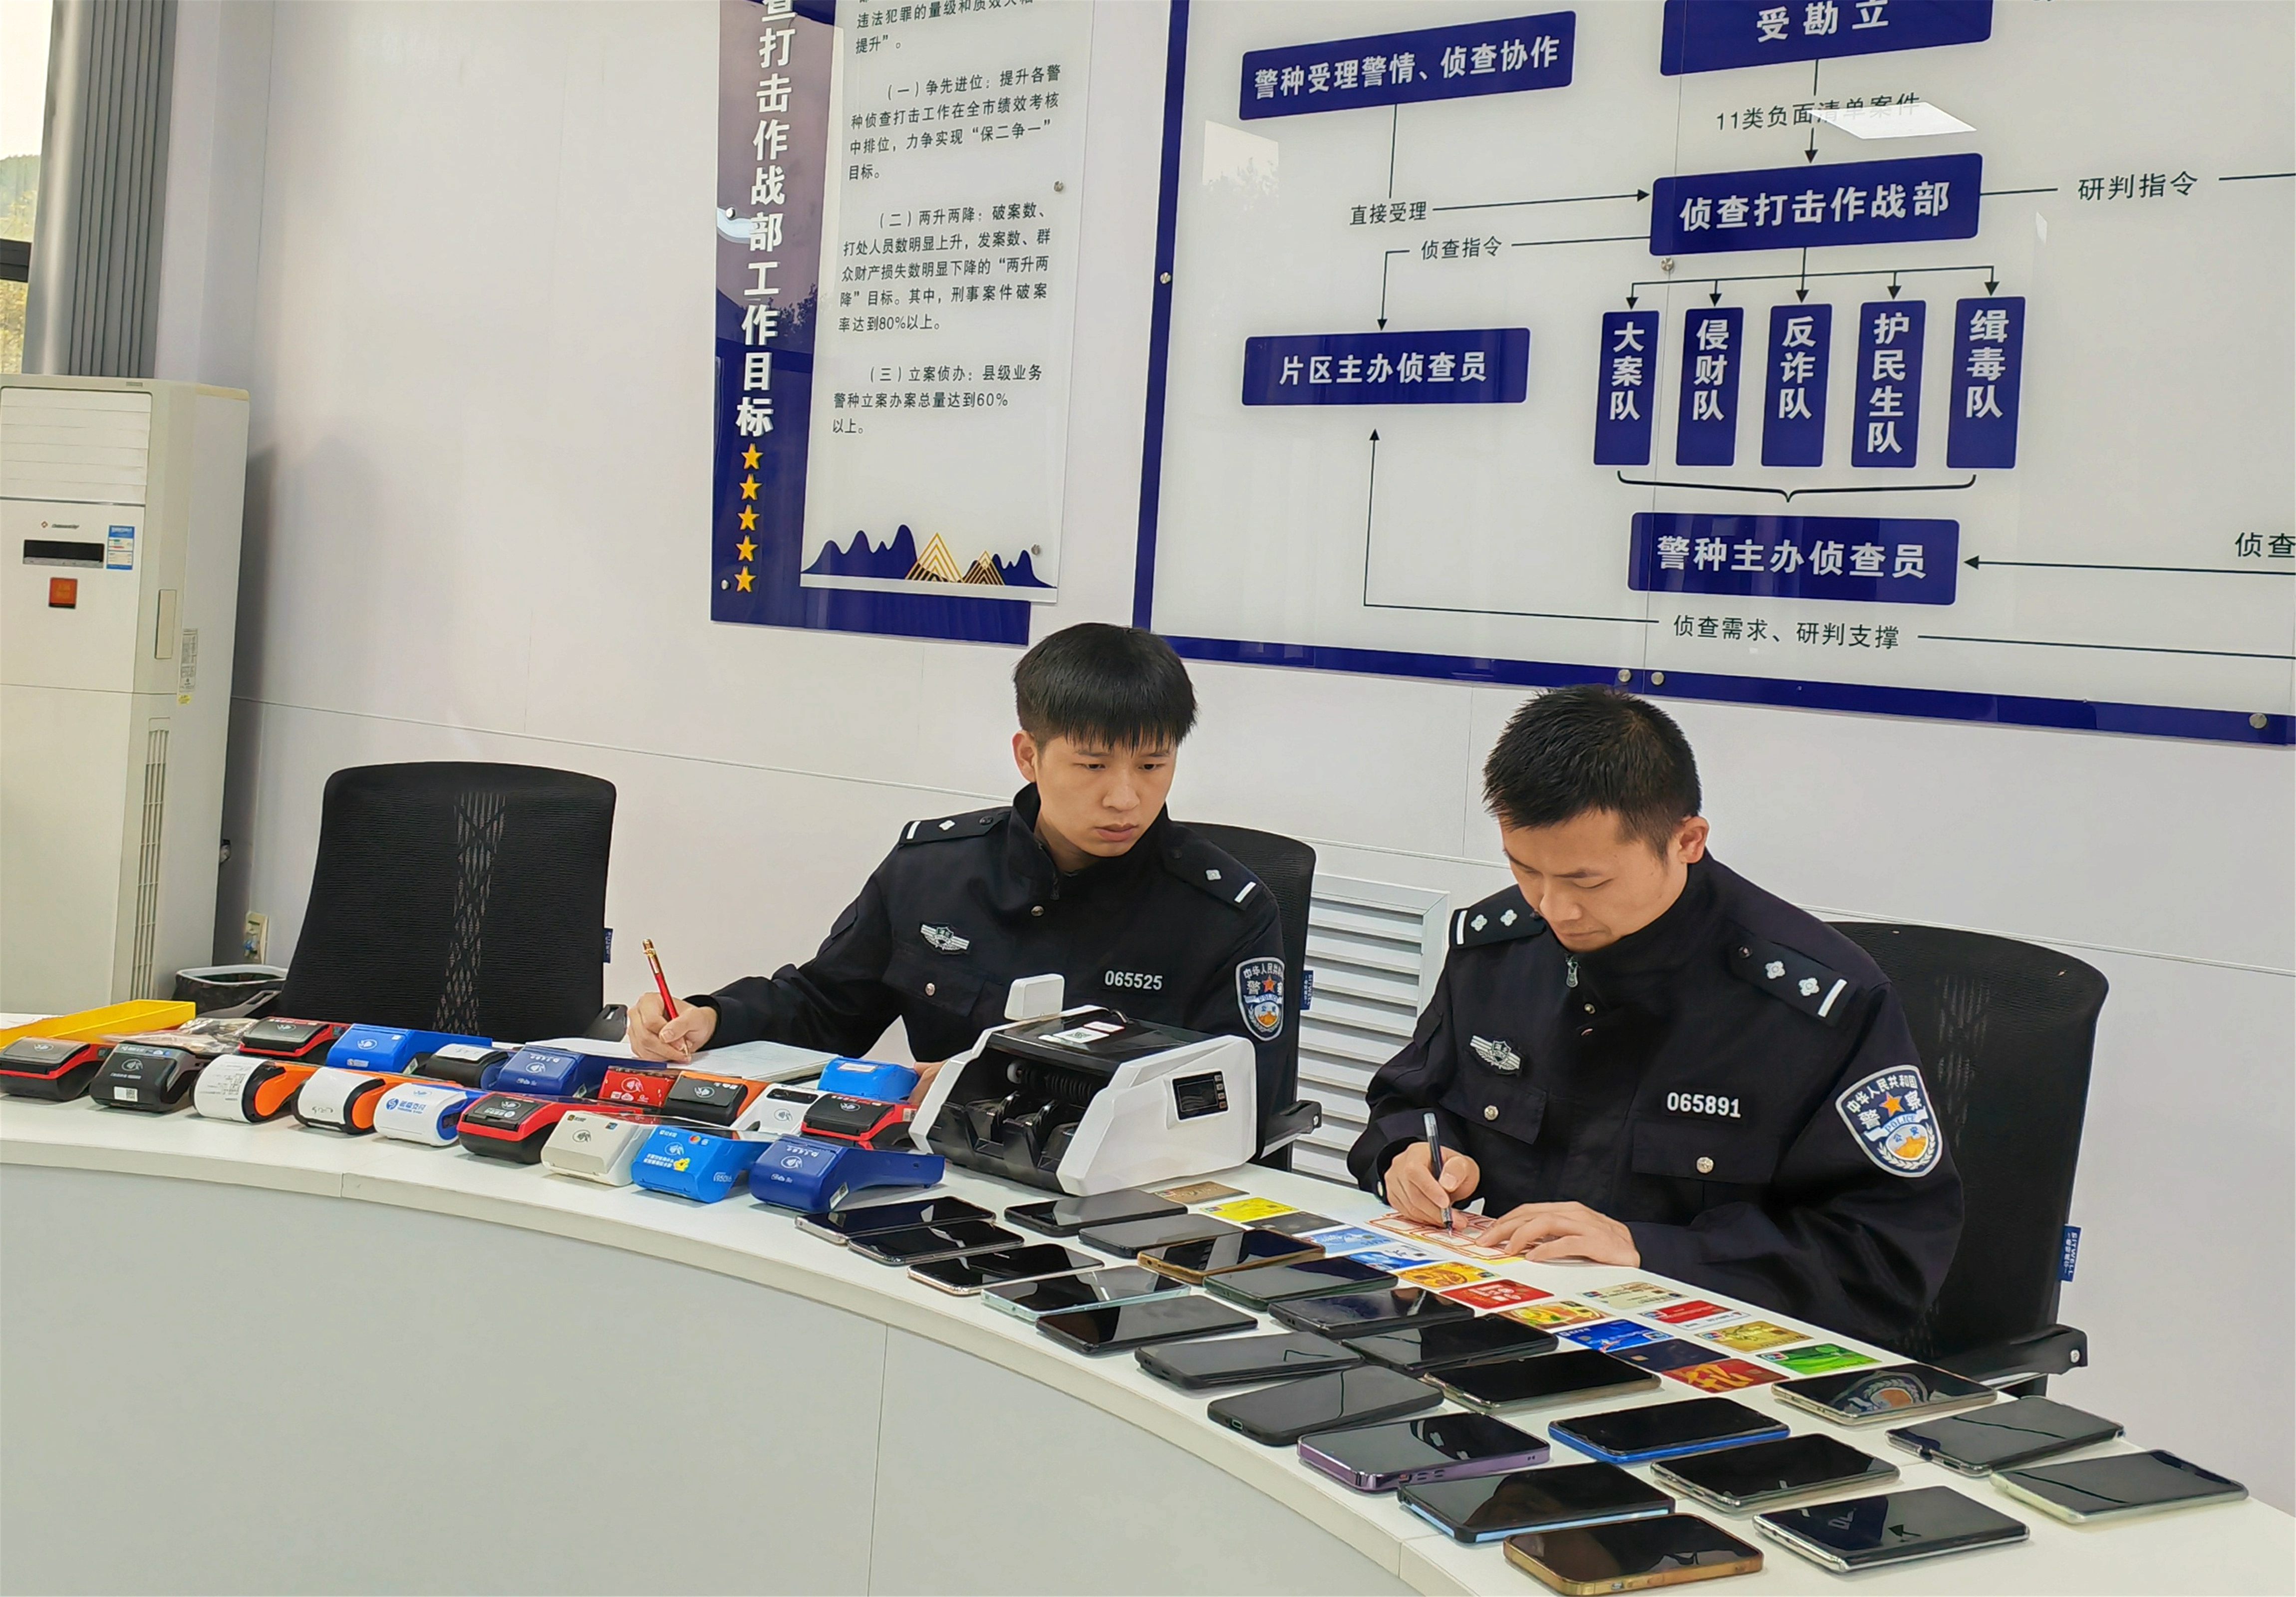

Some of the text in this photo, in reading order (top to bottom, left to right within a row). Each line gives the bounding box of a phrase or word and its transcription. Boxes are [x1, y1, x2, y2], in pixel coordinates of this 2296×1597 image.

[1756, 0, 1889, 42] 受勘立
[1255, 36, 1559, 99] 警种受理警情、侦查协作
[852, 92, 1059, 129] 种侦查打击工作在全市绩效考核
[850, 164, 879, 180] 目标。
[2078, 171, 2198, 200] 研判指令
[1350, 202, 1426, 225] 直接受理
[1680, 181, 1949, 231] 侦查打击作战部
[844, 228, 1050, 256] 打处人员数明显上升，发案数、群
[1422, 236, 1501, 260] 侦查指令
[839, 314, 939, 332] 率达到80%以上。
[1280, 352, 1486, 385] 片区主办侦查员
[1610, 322, 1644, 420] 大案队
[1693, 319, 1728, 420] 侵财队
[1779, 316, 1815, 419] 反诈队
[1967, 310, 2009, 418] 缉毒队
[1868, 312, 1909, 453] 护民生队
[834, 392, 1007, 408] 警种立案办案总量达到60%
[833, 418, 862, 433] 以上。
[1658, 536, 1926, 578] 警种主办侦查员
[2235, 532, 2296, 558] 侦查
[1674, 615, 1898, 649] 侦查需求、研判支撑
[1105, 970, 1163, 990] 065525
[1243, 963, 1283, 979] 中华人民共
[1667, 1092, 1741, 1118] 065891
[1846, 1074, 1919, 1114] 中华人民共和国
[1884, 1114, 1916, 1132] POLICE
